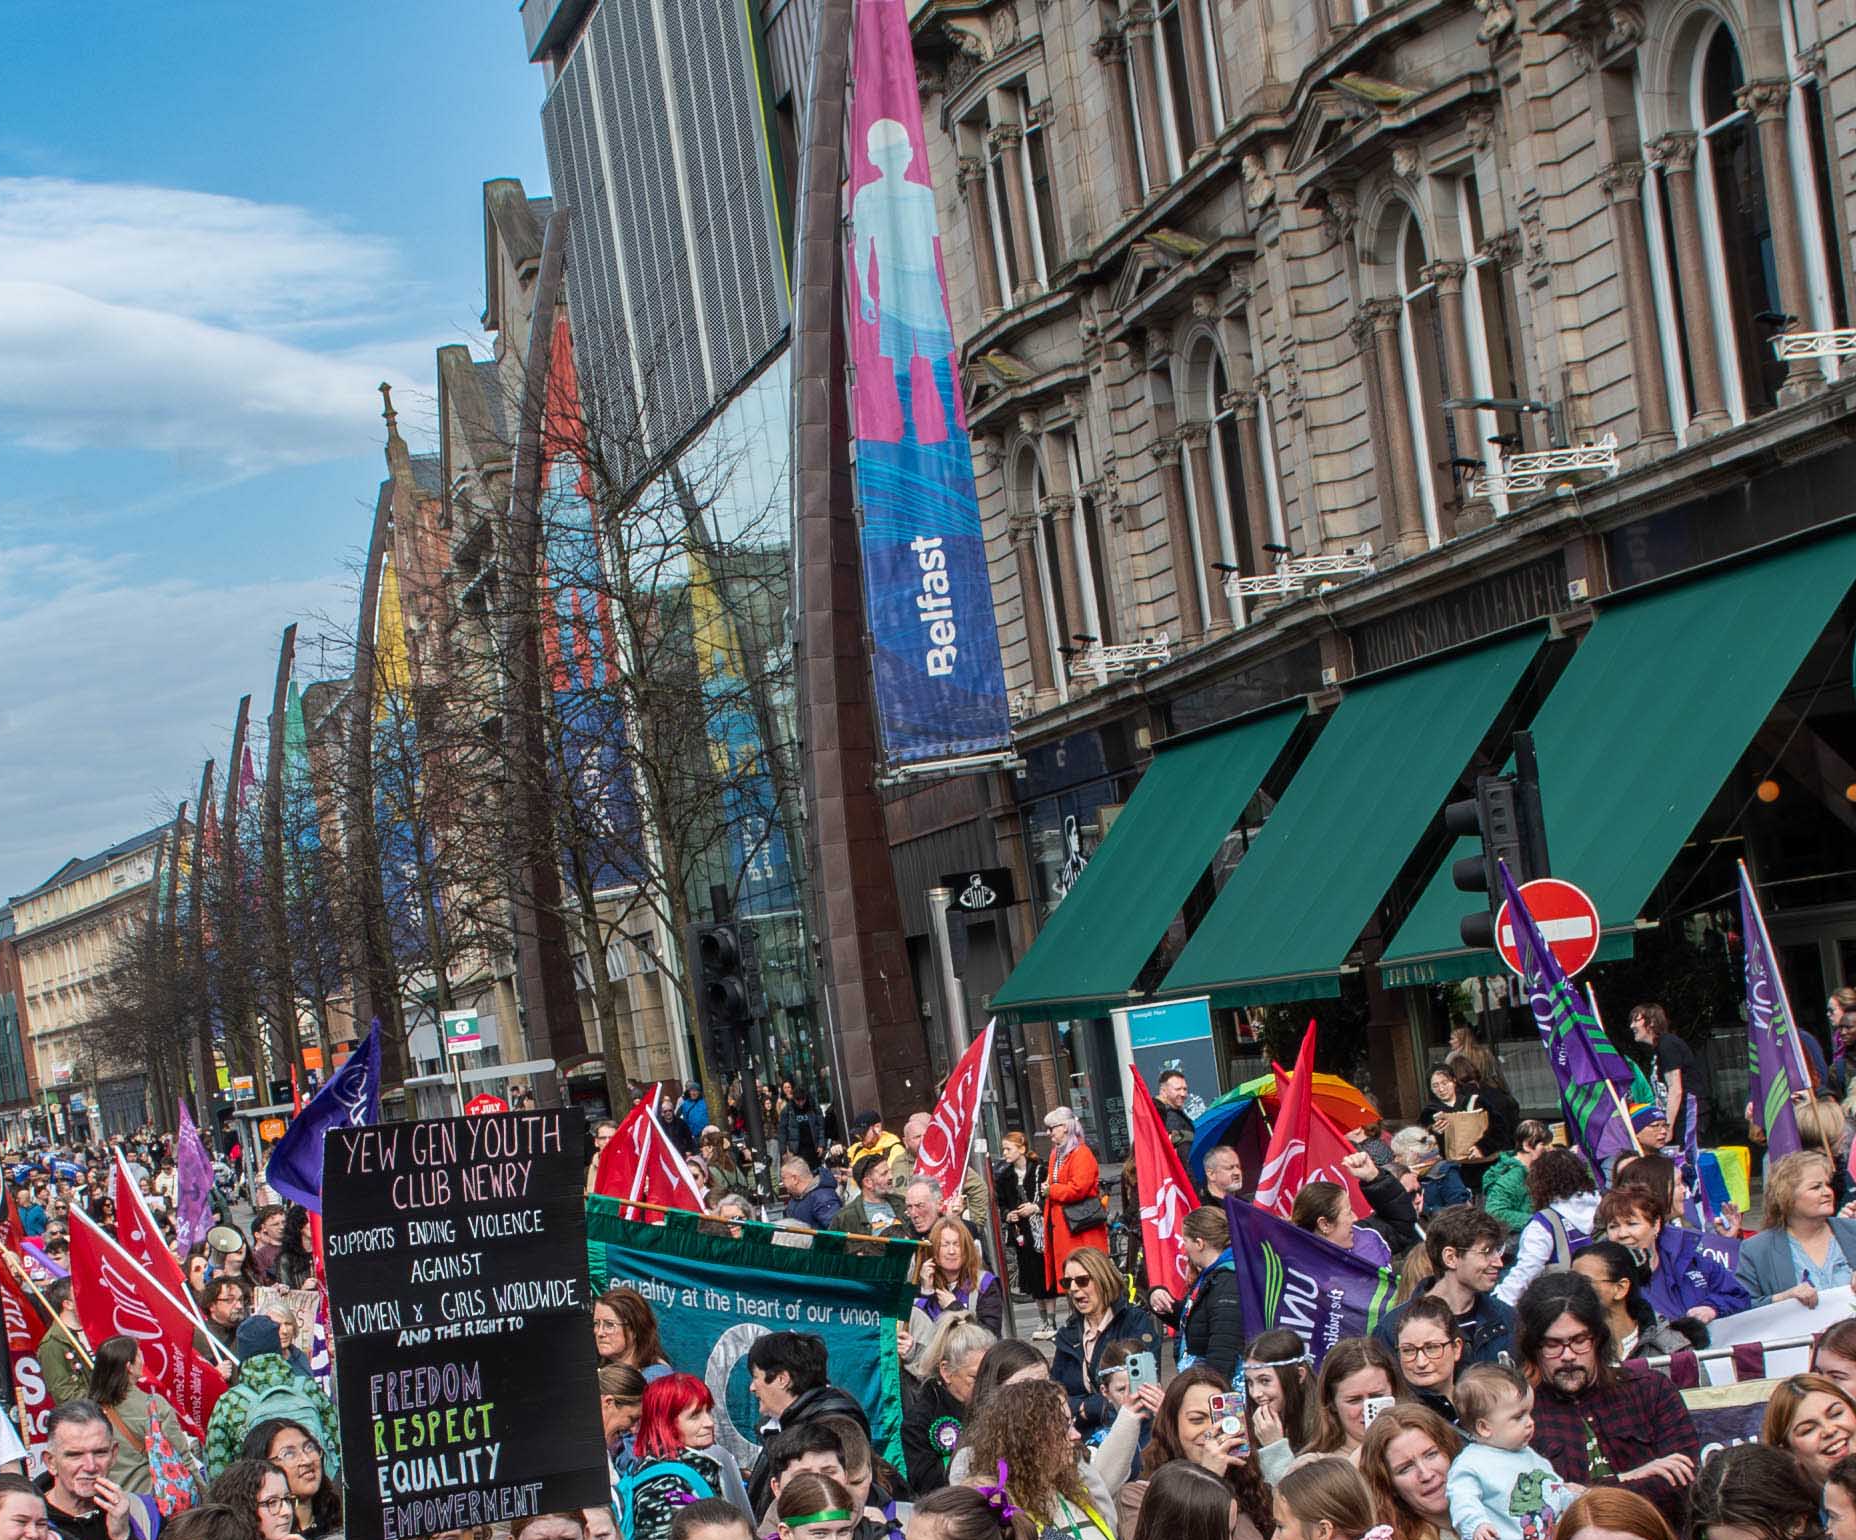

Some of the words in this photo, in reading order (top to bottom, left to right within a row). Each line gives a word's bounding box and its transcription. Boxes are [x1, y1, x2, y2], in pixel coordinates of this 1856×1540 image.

[910, 535, 958, 677] Belfast
[342, 1128, 409, 1175] YEW
[413, 1123, 457, 1167] GEN
[466, 1114, 562, 1159] YOUTH
[392, 1171, 451, 1210] CLUB
[462, 1160, 533, 1203] NEWRY
[329, 1226, 396, 1258] SUPPORTS
[408, 1219, 457, 1247] ENDING
[467, 1209, 545, 1240] VIOLENCE
[410, 1253, 483, 1284] AGAINST
[339, 1299, 402, 1336] WOMEN
[441, 1291, 486, 1322] GIRLS
[493, 1279, 581, 1314] WORLDWIDE
[397, 1326, 431, 1348] AND
[435, 1324, 462, 1343] THE
[466, 1319, 502, 1338] RIGHT
[505, 1315, 525, 1332] TO
[681, 1286, 699, 1309] at
[704, 1288, 731, 1312] the
[736, 1291, 781, 1320] heart
[785, 1299, 803, 1321] of
[807, 1308, 834, 1324] our
[840, 1308, 881, 1327] union
[370, 1360, 483, 1416] FREEDOM
[373, 1402, 496, 1456] RESPECT
[378, 1441, 502, 1499] EQUALITY
